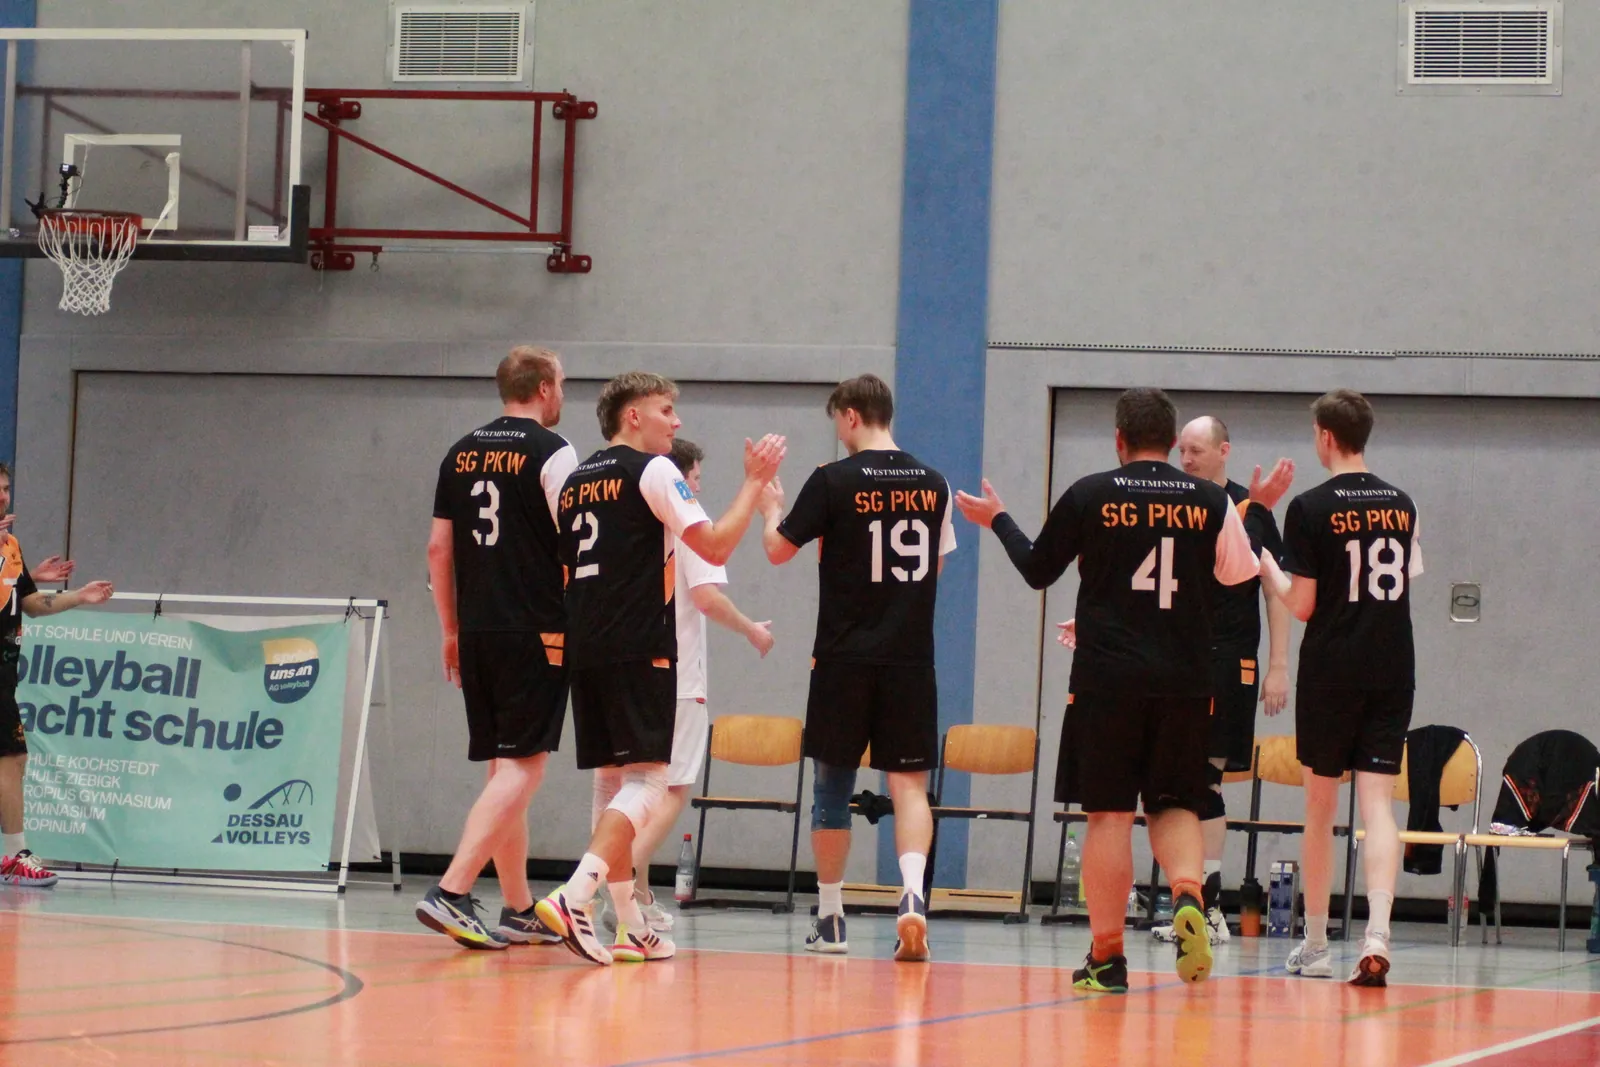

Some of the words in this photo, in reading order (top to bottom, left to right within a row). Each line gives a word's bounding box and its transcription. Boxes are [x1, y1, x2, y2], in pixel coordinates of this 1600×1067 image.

[473, 429, 526, 438] WESTMINSTER
[455, 450, 479, 473] SG
[483, 451, 527, 475] PKW
[862, 467, 926, 476] WESTMINSTER
[1113, 476, 1196, 490] WESTMINSTER
[1334, 488, 1398, 498] WESTMINSTER
[560, 486, 574, 513] SG
[579, 478, 622, 505] PKW
[855, 491, 883, 513] SG
[890, 489, 937, 512] PKW
[470, 480, 500, 546] 3
[1101, 502, 1138, 528] SG
[1148, 503, 1208, 530] PKW
[1330, 510, 1361, 534] SG
[1366, 509, 1410, 532] PKW
[571, 511, 599, 579] 2
[868, 519, 930, 583] 19
[1131, 536, 1178, 609] 4
[1345, 537, 1404, 602] 18
[22, 624, 43, 637] KT
[44, 625, 103, 642] SCHULE
[105, 629, 136, 644] UND
[139, 632, 193, 651] VEREIN
[269, 669, 296, 680] uns
[123, 706, 284, 751] schule
[67, 756, 160, 776] KOCHSTEDT
[66, 771, 121, 788] ZIEBIGK
[79, 789, 172, 810] GYMNASIUM
[227, 813, 303, 828] DESSAU
[226, 830, 311, 845] VOLLEYS
